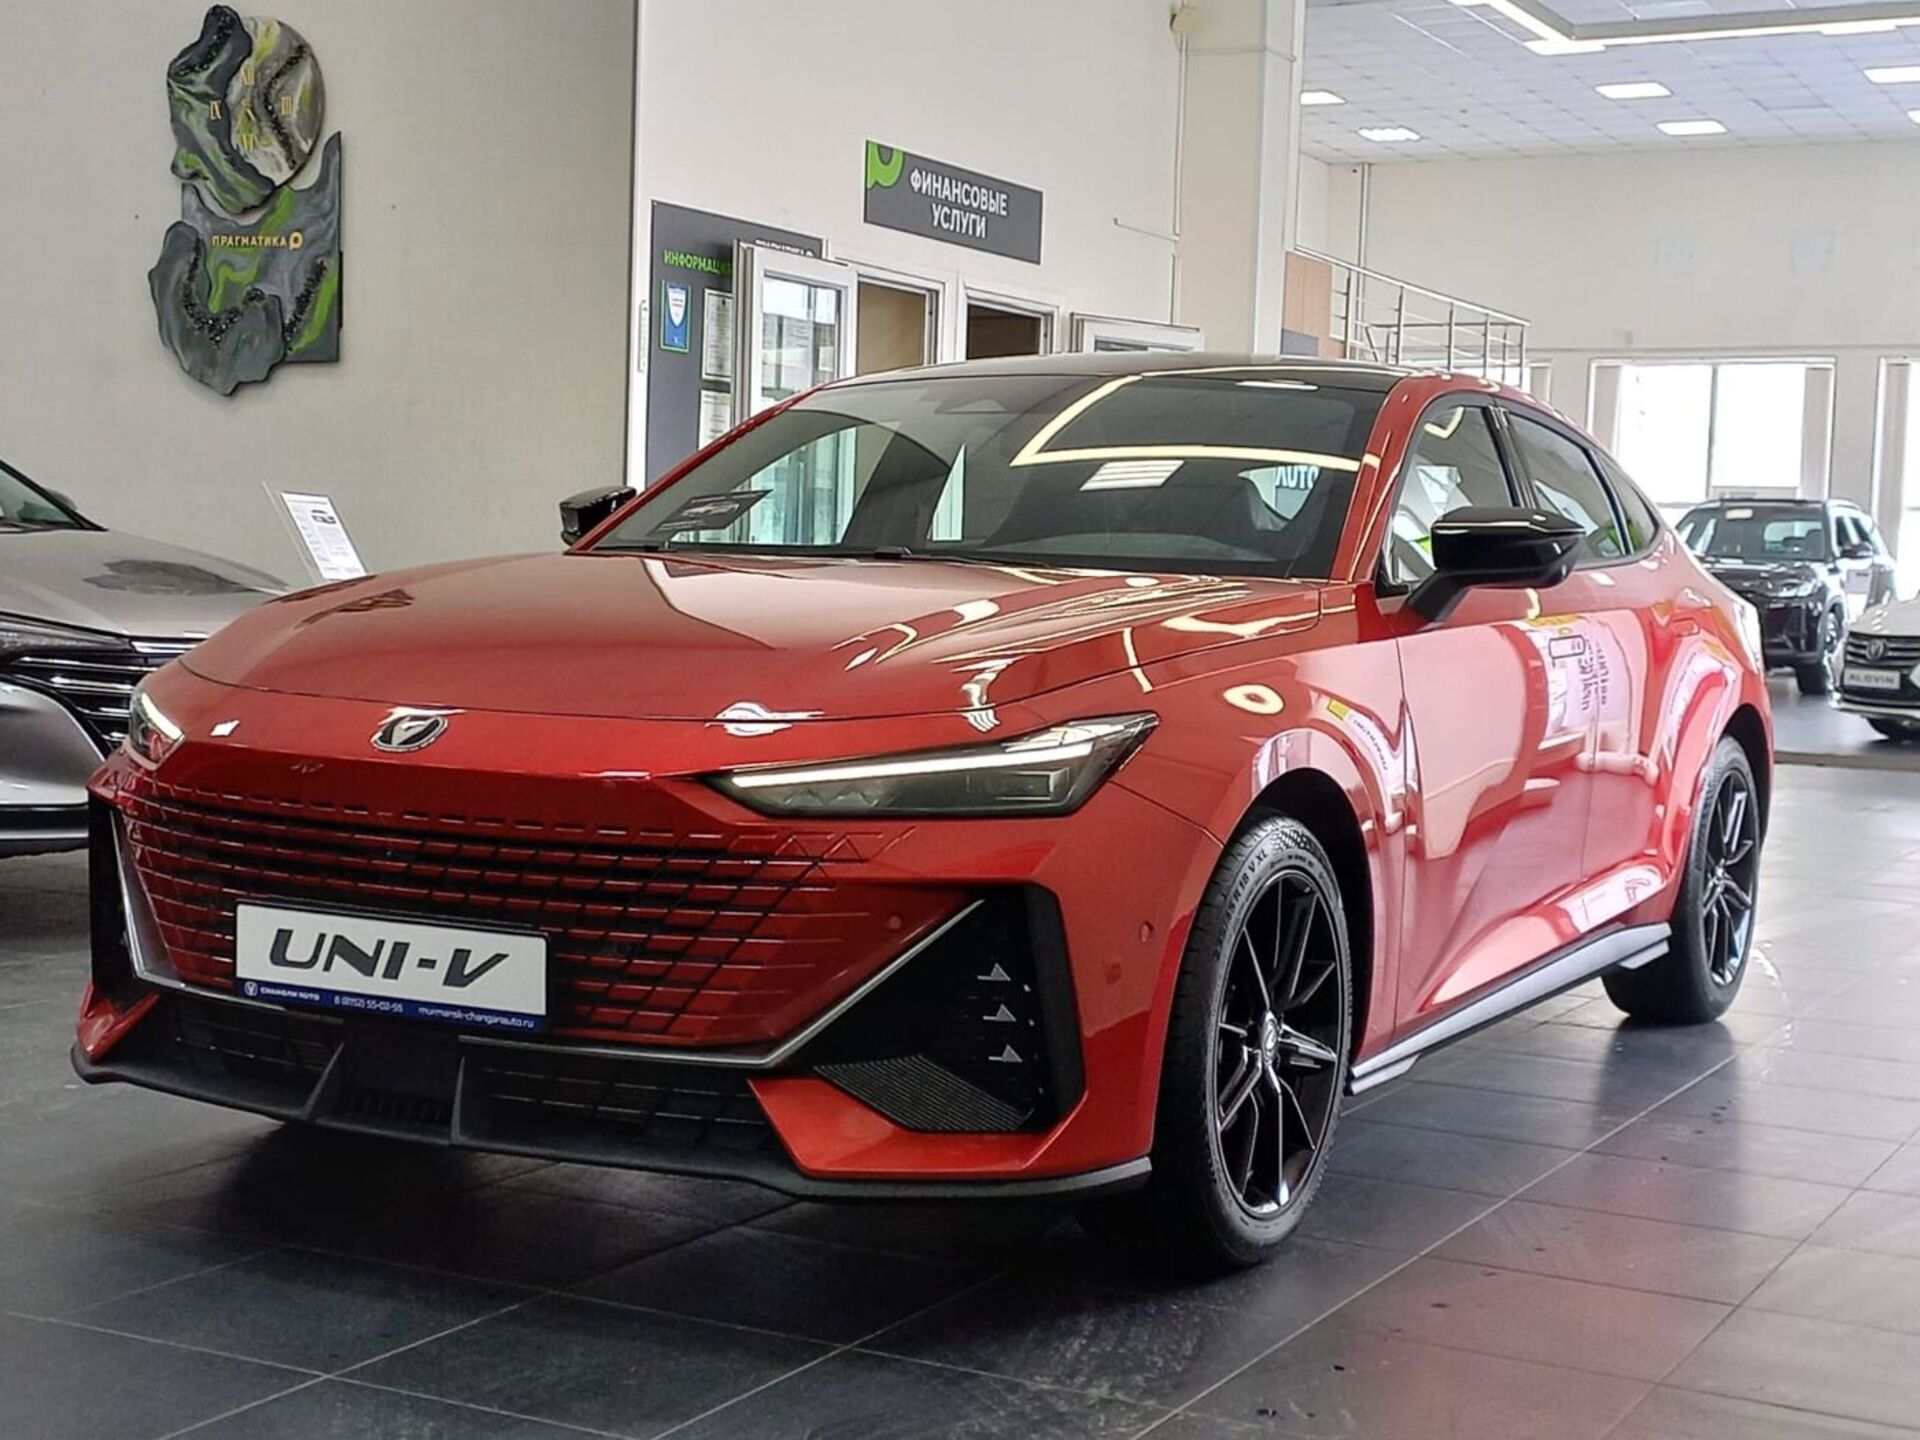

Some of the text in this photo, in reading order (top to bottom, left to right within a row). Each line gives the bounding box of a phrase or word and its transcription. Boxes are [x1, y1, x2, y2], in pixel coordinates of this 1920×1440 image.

[910, 168, 1009, 217] ФИНАНСОВЫЕ
[931, 202, 987, 239] УСЛУГИ
[212, 234, 287, 248] ПРАГМАТИКА
[663, 248, 729, 276] ИНФОРМАЦ
[268, 928, 510, 989] UNI-V
[418, 1005, 534, 1028] murmansk-changanauto.ru
